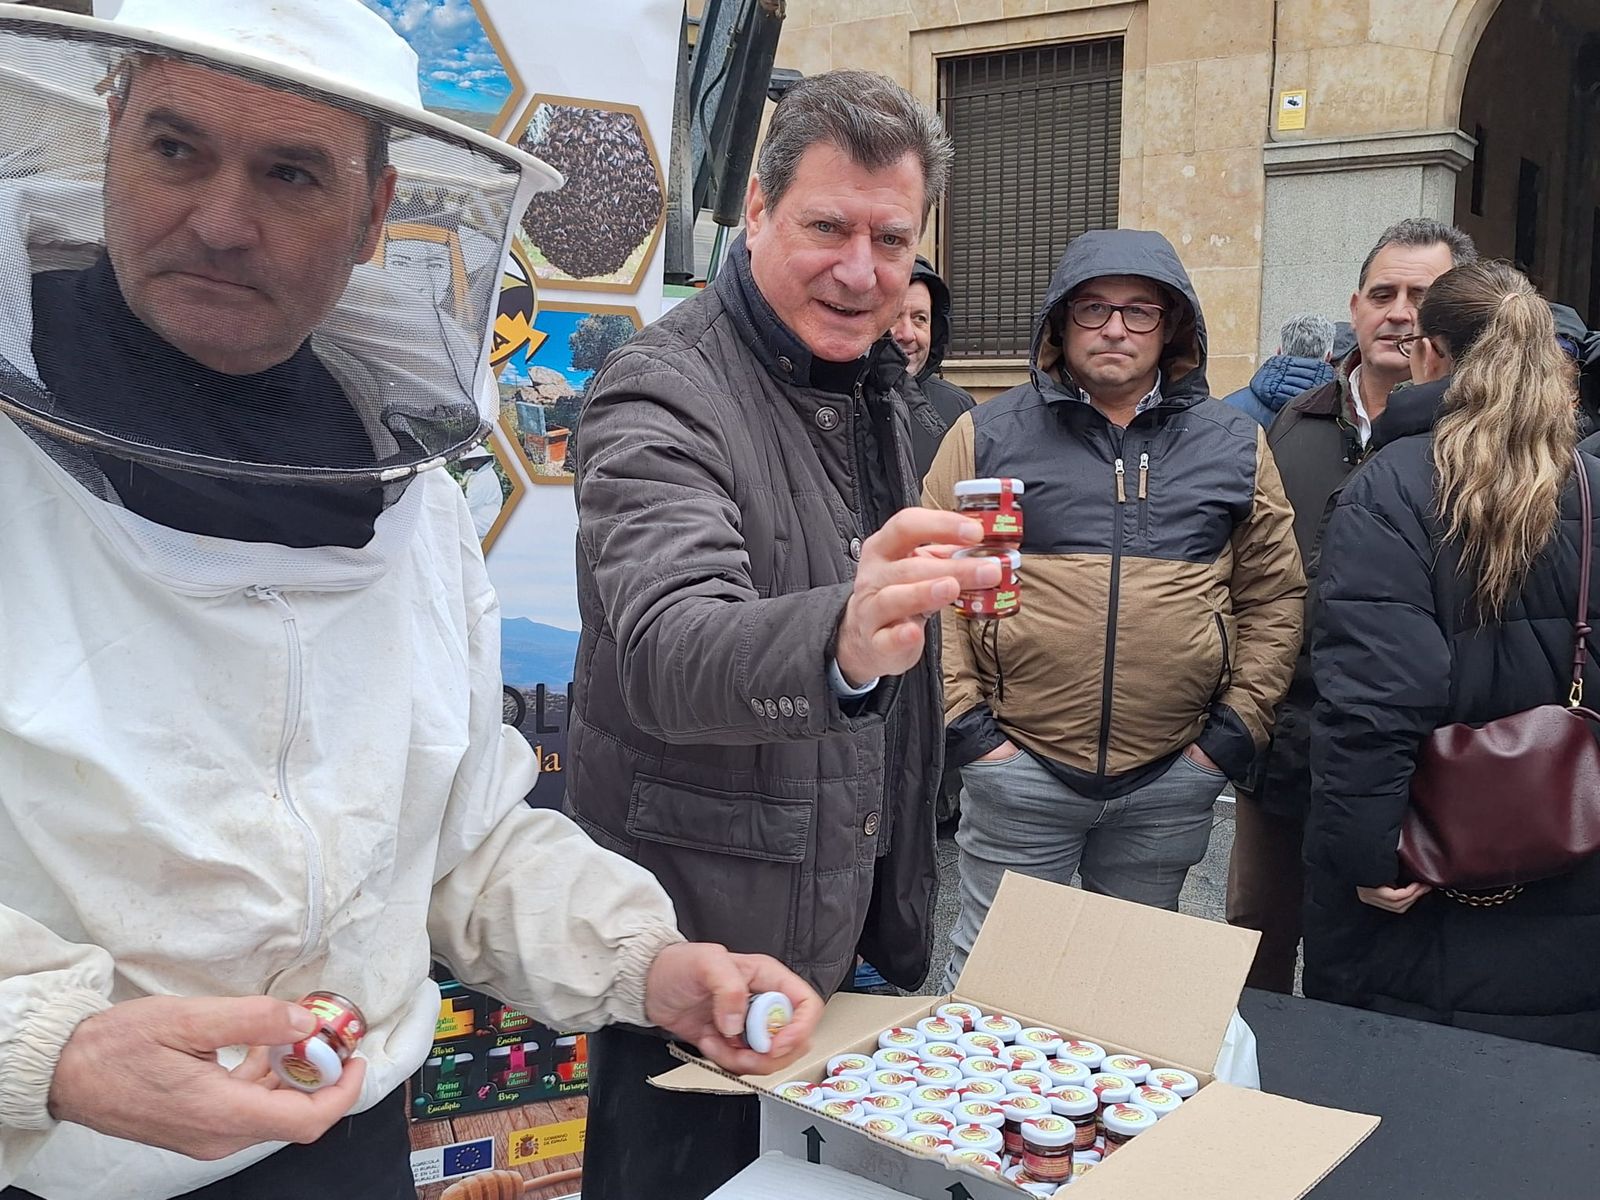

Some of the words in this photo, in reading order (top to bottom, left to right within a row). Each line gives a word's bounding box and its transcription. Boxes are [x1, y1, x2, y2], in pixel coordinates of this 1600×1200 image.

[496, 1036, 522, 1047] Encina
[437, 1081, 460, 1091] Reina
[427, 1101, 462, 1114] Eucalipto
